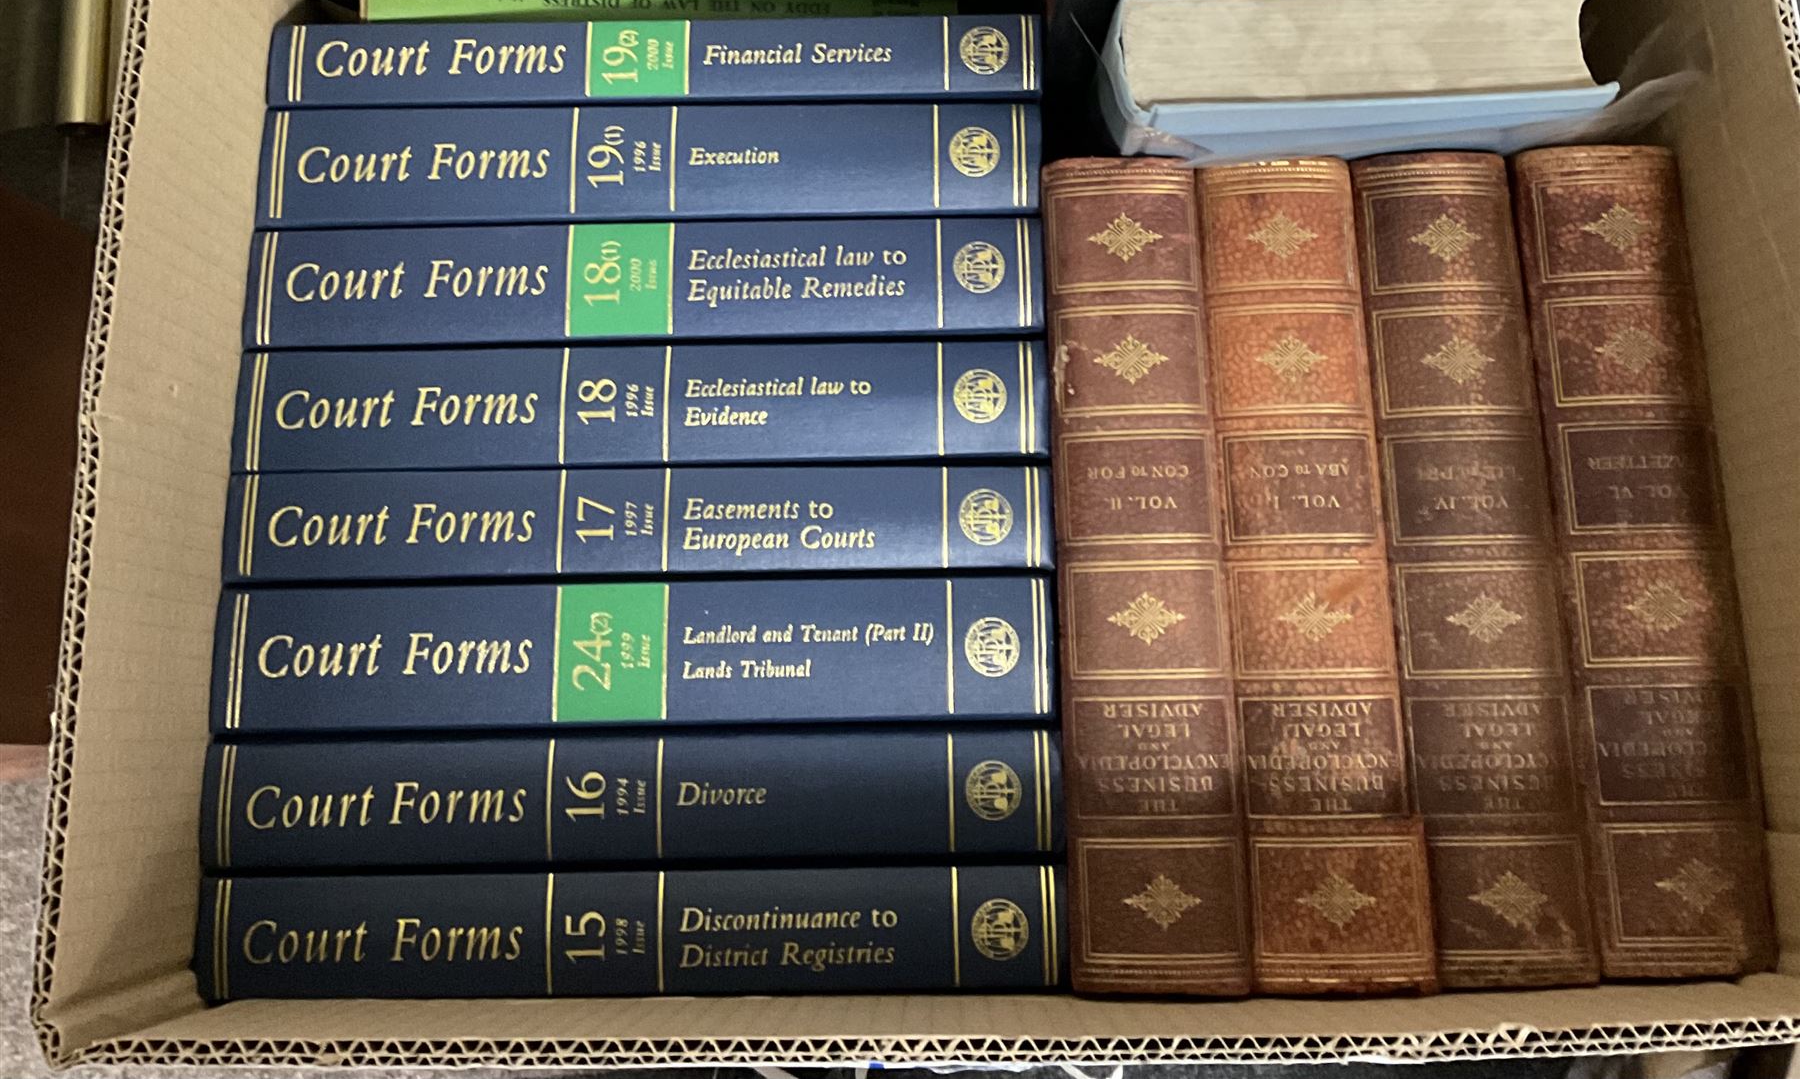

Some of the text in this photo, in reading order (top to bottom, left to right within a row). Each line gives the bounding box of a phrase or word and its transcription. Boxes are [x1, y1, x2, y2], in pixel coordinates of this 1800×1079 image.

[709, 0, 740, 12] THE
[315, 38, 567, 78] Court Forms
[602, 30, 639, 83] 19(2)
[662, 41, 674, 69] Issue
[703, 43, 892, 66] Financial Services
[297, 143, 550, 184] Court Forms
[587, 125, 626, 188] 19(1)
[633, 140, 648, 172] 1996
[650, 142, 662, 172] Issue
[689, 146, 780, 166] Execution
[688, 245, 907, 271] Ecclesiastical law to
[286, 259, 549, 303] Court Forms
[584, 240, 622, 308] 18(1)
[645, 259, 658, 290] Issue
[687, 275, 906, 308] Equitable Remedies
[577, 378, 618, 426] 18
[626, 383, 639, 418] 1996
[642, 387, 655, 418] Issue
[685, 377, 871, 399] Ecclesiastical law to
[274, 386, 538, 431] Court Forms
[684, 406, 768, 426] Evidence
[1087, 464, 1189, 481] CON FOR
[1315, 463, 1349, 478] ABA
[684, 498, 833, 520] Easements to
[1130, 495, 1178, 510] VOL.
[1291, 494, 1340, 509] VOL.
[268, 502, 536, 548] Court Forms
[576, 496, 615, 544] 17
[625, 501, 639, 537] 1997
[641, 504, 655, 536] Issue
[683, 525, 876, 556] European Courts
[683, 622, 934, 647] Landlord and Tenant (Part II)
[257, 632, 533, 679] Court Forms
[572, 612, 613, 691] 24(2)
[621, 632, 635, 669] 1999
[638, 634, 651, 669] Issue
[682, 659, 811, 679] Lands Tribunal
[1103, 703, 1204, 718] ADVISER
[1273, 702, 1372, 716] ADVISER
[1122, 724, 1191, 738] LEGAL
[1292, 722, 1361, 737] LEGAL
[1464, 723, 1532, 737] LEGAL
[1137, 742, 1170, 751] AND
[1308, 741, 1340, 750] AND
[565, 770, 607, 823] 16
[615, 777, 629, 816] 1994
[633, 779, 647, 815] Issue
[676, 781, 767, 807] Divorce
[1101, 777, 1214, 793] BUSINESS
[1268, 775, 1385, 792] BUSINESS
[246, 781, 527, 830] Court Forms
[1138, 799, 1178, 813] THE
[1312, 798, 1352, 811] THE
[680, 906, 897, 933] Discontinuance to
[243, 917, 524, 965] Court Forms
[565, 910, 606, 964] 15
[615, 918, 629, 957] 1998
[632, 920, 646, 955] Issue
[680, 941, 895, 972] District Registries
